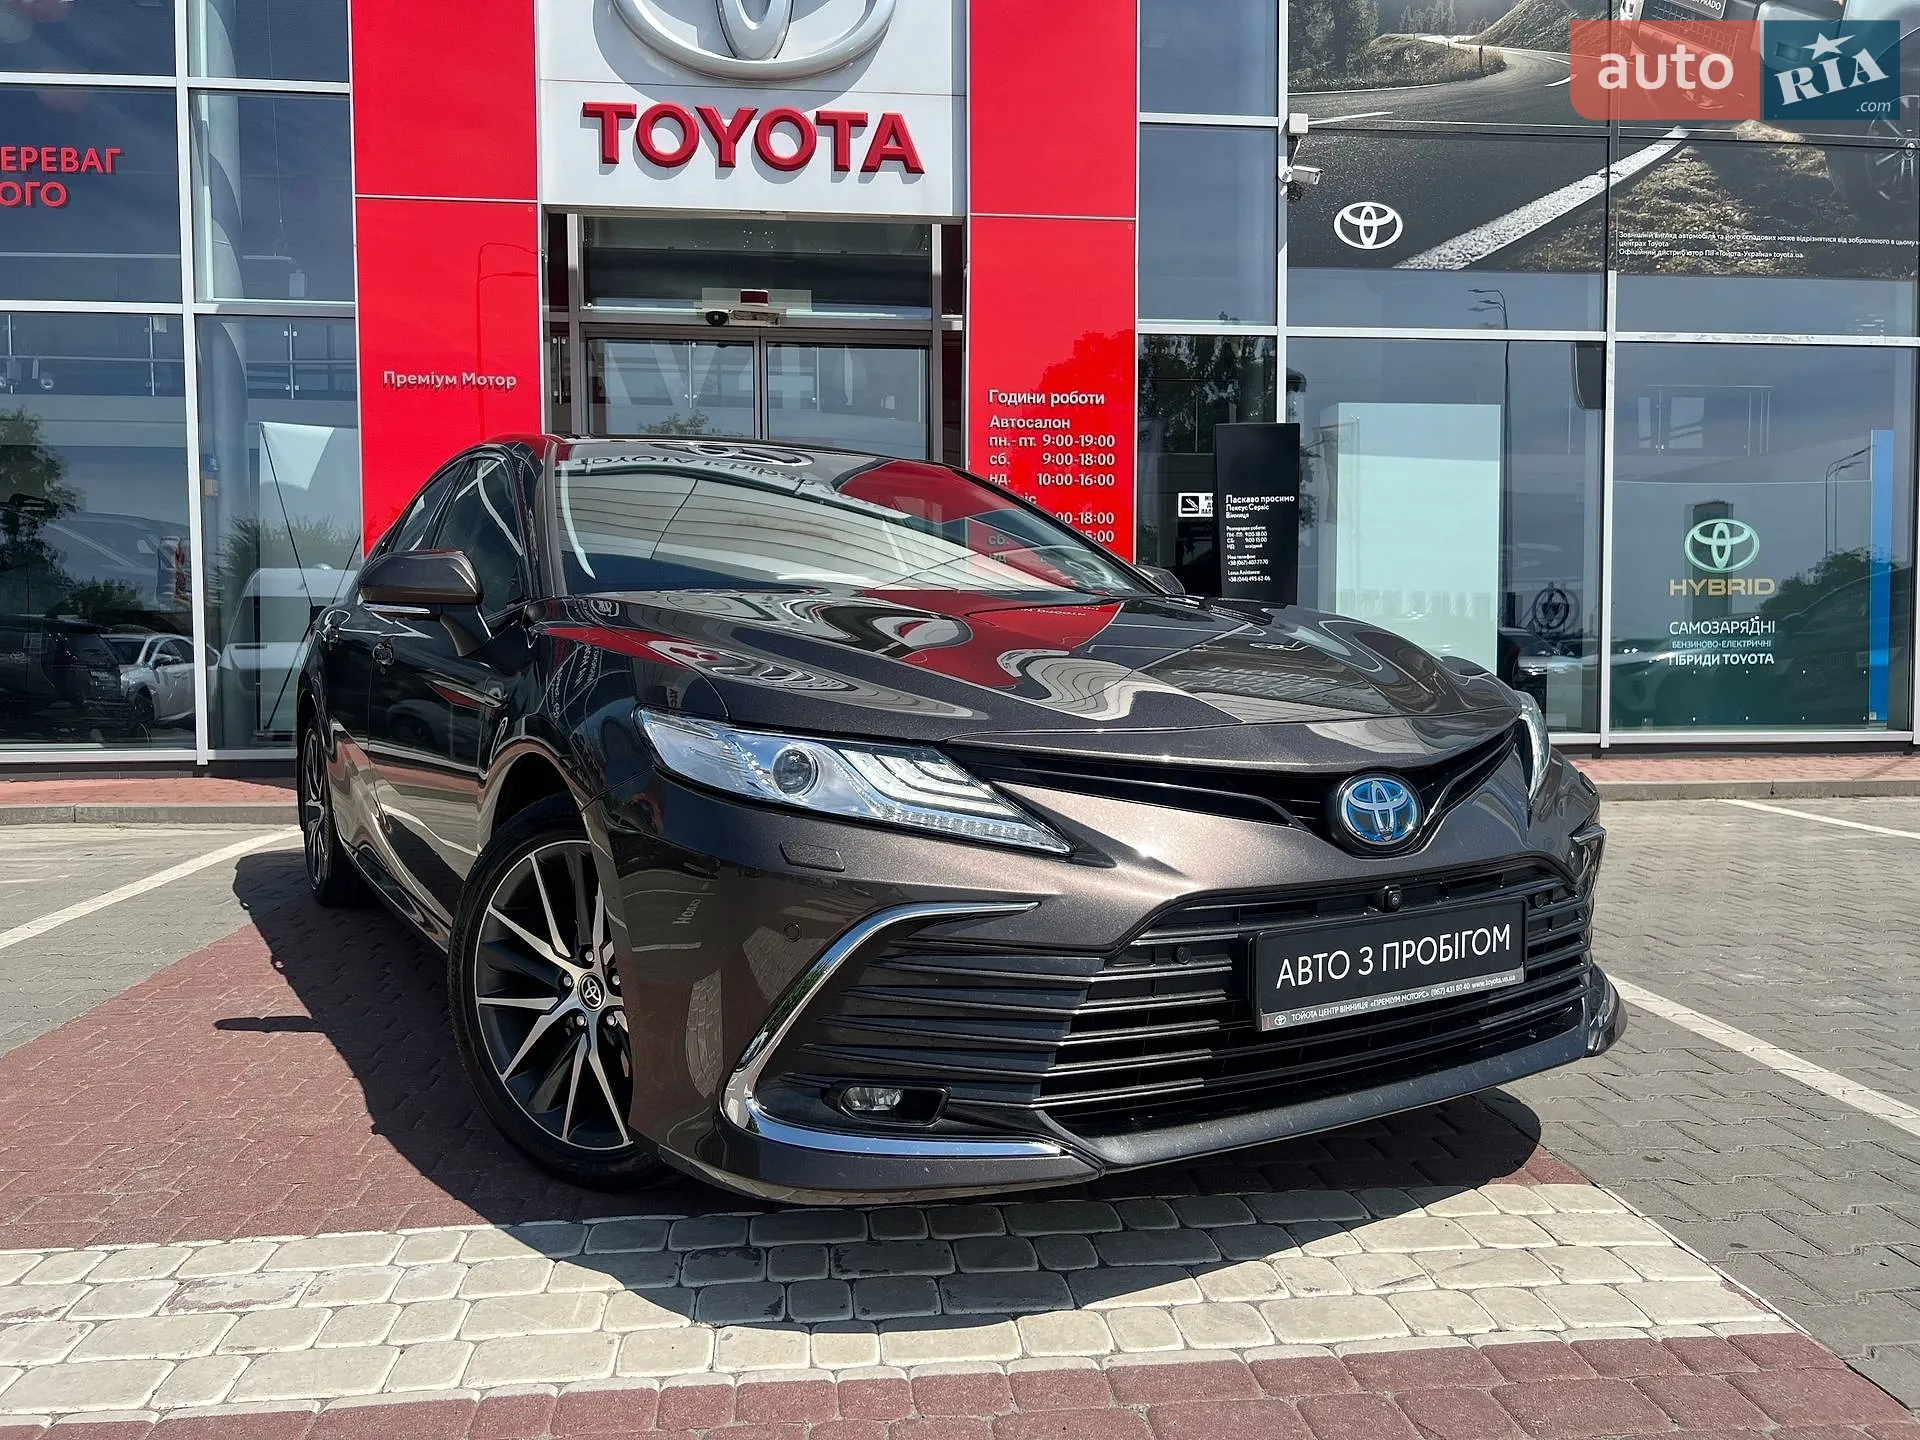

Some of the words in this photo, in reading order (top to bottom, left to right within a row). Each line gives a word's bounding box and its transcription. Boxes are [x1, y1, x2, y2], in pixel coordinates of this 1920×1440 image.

[582, 102, 925, 174] TOYOTA
[384, 371, 457, 388] Преміум
[462, 371, 517, 389] Мотор
[989, 389, 1046, 405] Години
[1050, 390, 1105, 407] роботи
[989, 415, 1071, 429] Автосалон
[1042, 433, 1115, 447] 9:00-19:00
[989, 452, 1011, 465] сб.
[1042, 452, 1115, 466] 9:00-18:00
[989, 473, 1011, 485] нд.
[1037, 472, 1115, 486] 10:00-16:00
[1260, 495, 1295, 504] просимо
[1669, 578, 1776, 596] HYBRID
[1669, 620, 1776, 636] САМОЗАРЯДНІ
[1672, 640, 1772, 649] БЕНЗИНОВО-ЕЛЕКТРИЧНІ
[1669, 654, 1720, 667] ГІБРИДИ
[1723, 653, 1775, 665] TOYOTA
[1276, 950, 1350, 989] АВТО
[1382, 923, 1511, 972] ПРОБІГОМ
[1291, 1010, 1318, 1022] ТОЙОТА
[1318, 1006, 1339, 1017] ЦЕНТР
[1340, 1001, 1368, 1013] ВІННИЦЯ
